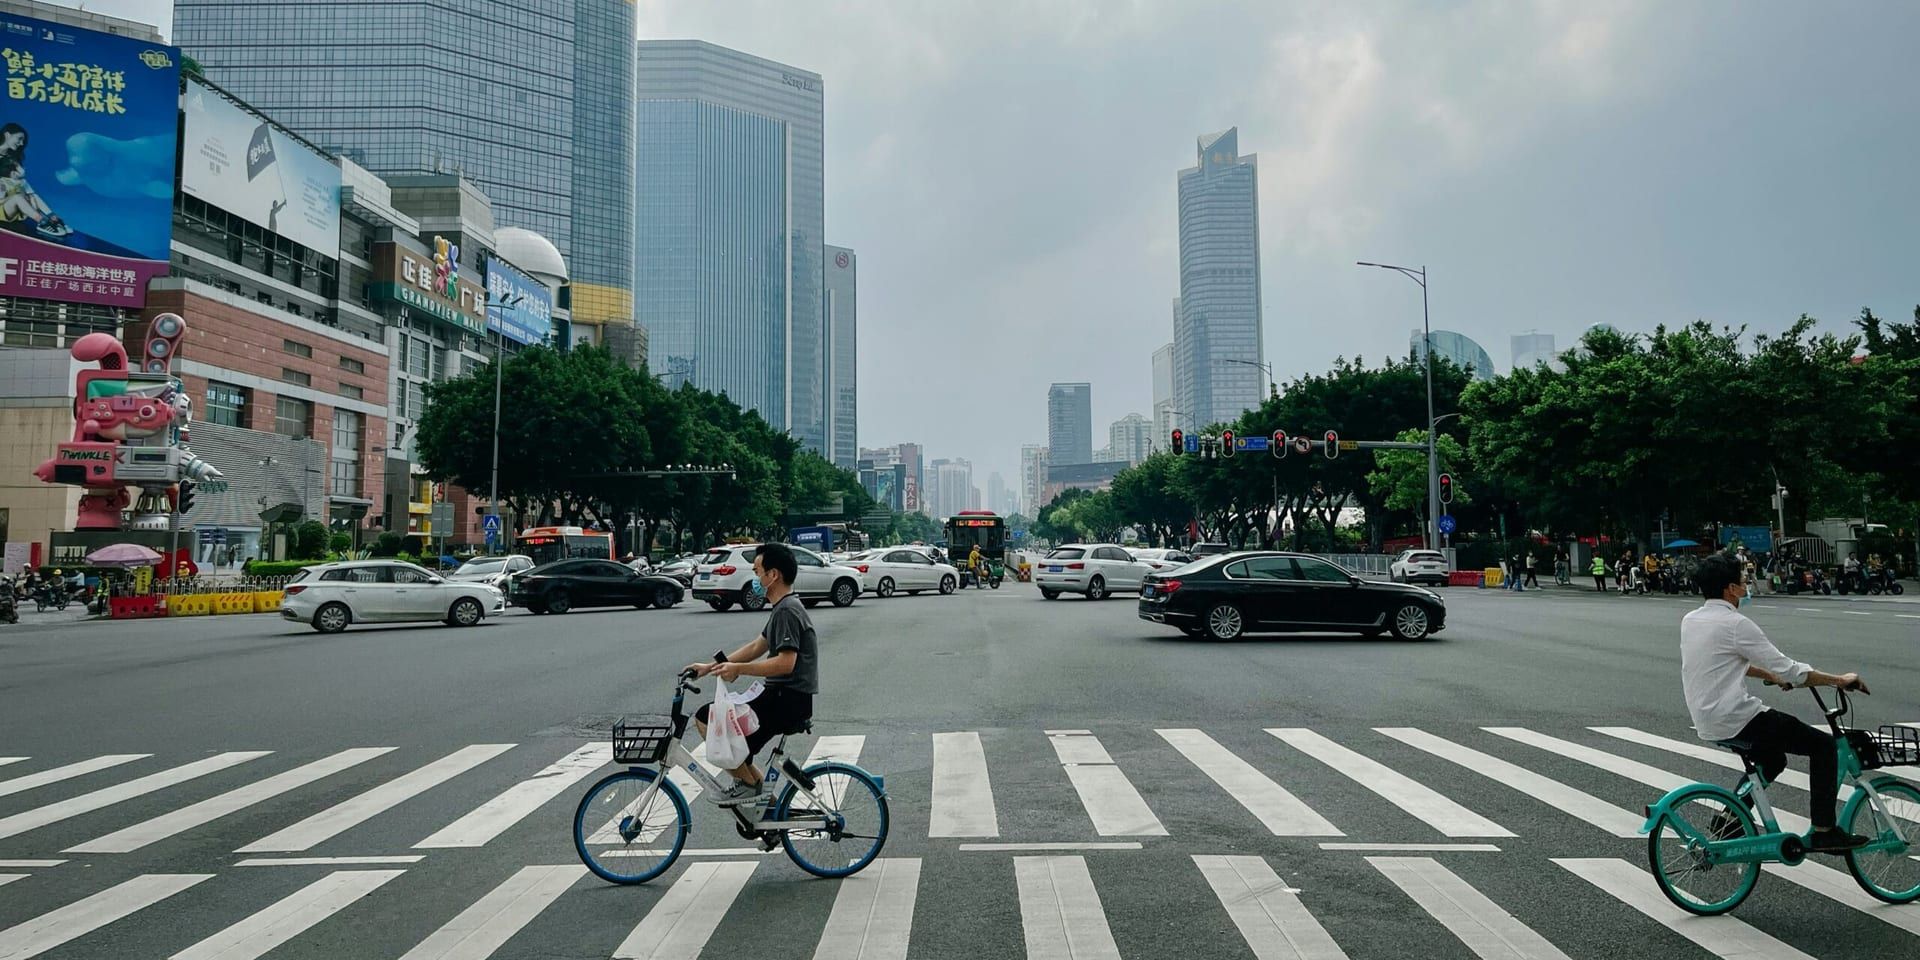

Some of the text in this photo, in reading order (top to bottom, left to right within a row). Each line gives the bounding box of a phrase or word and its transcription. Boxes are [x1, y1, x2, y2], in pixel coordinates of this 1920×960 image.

[1, 48, 126, 92] 鲸小五陪伴
[6, 77, 127, 114] 百万少儿成长
[26, 259, 137, 284] 正佳极地海洋世界
[26, 276, 135, 297] 正佳广场西北中庭
[401, 287, 458, 322] GRANDVIEW
[463, 315, 485, 333] MALL
[61, 449, 111, 461] TWINKLE
